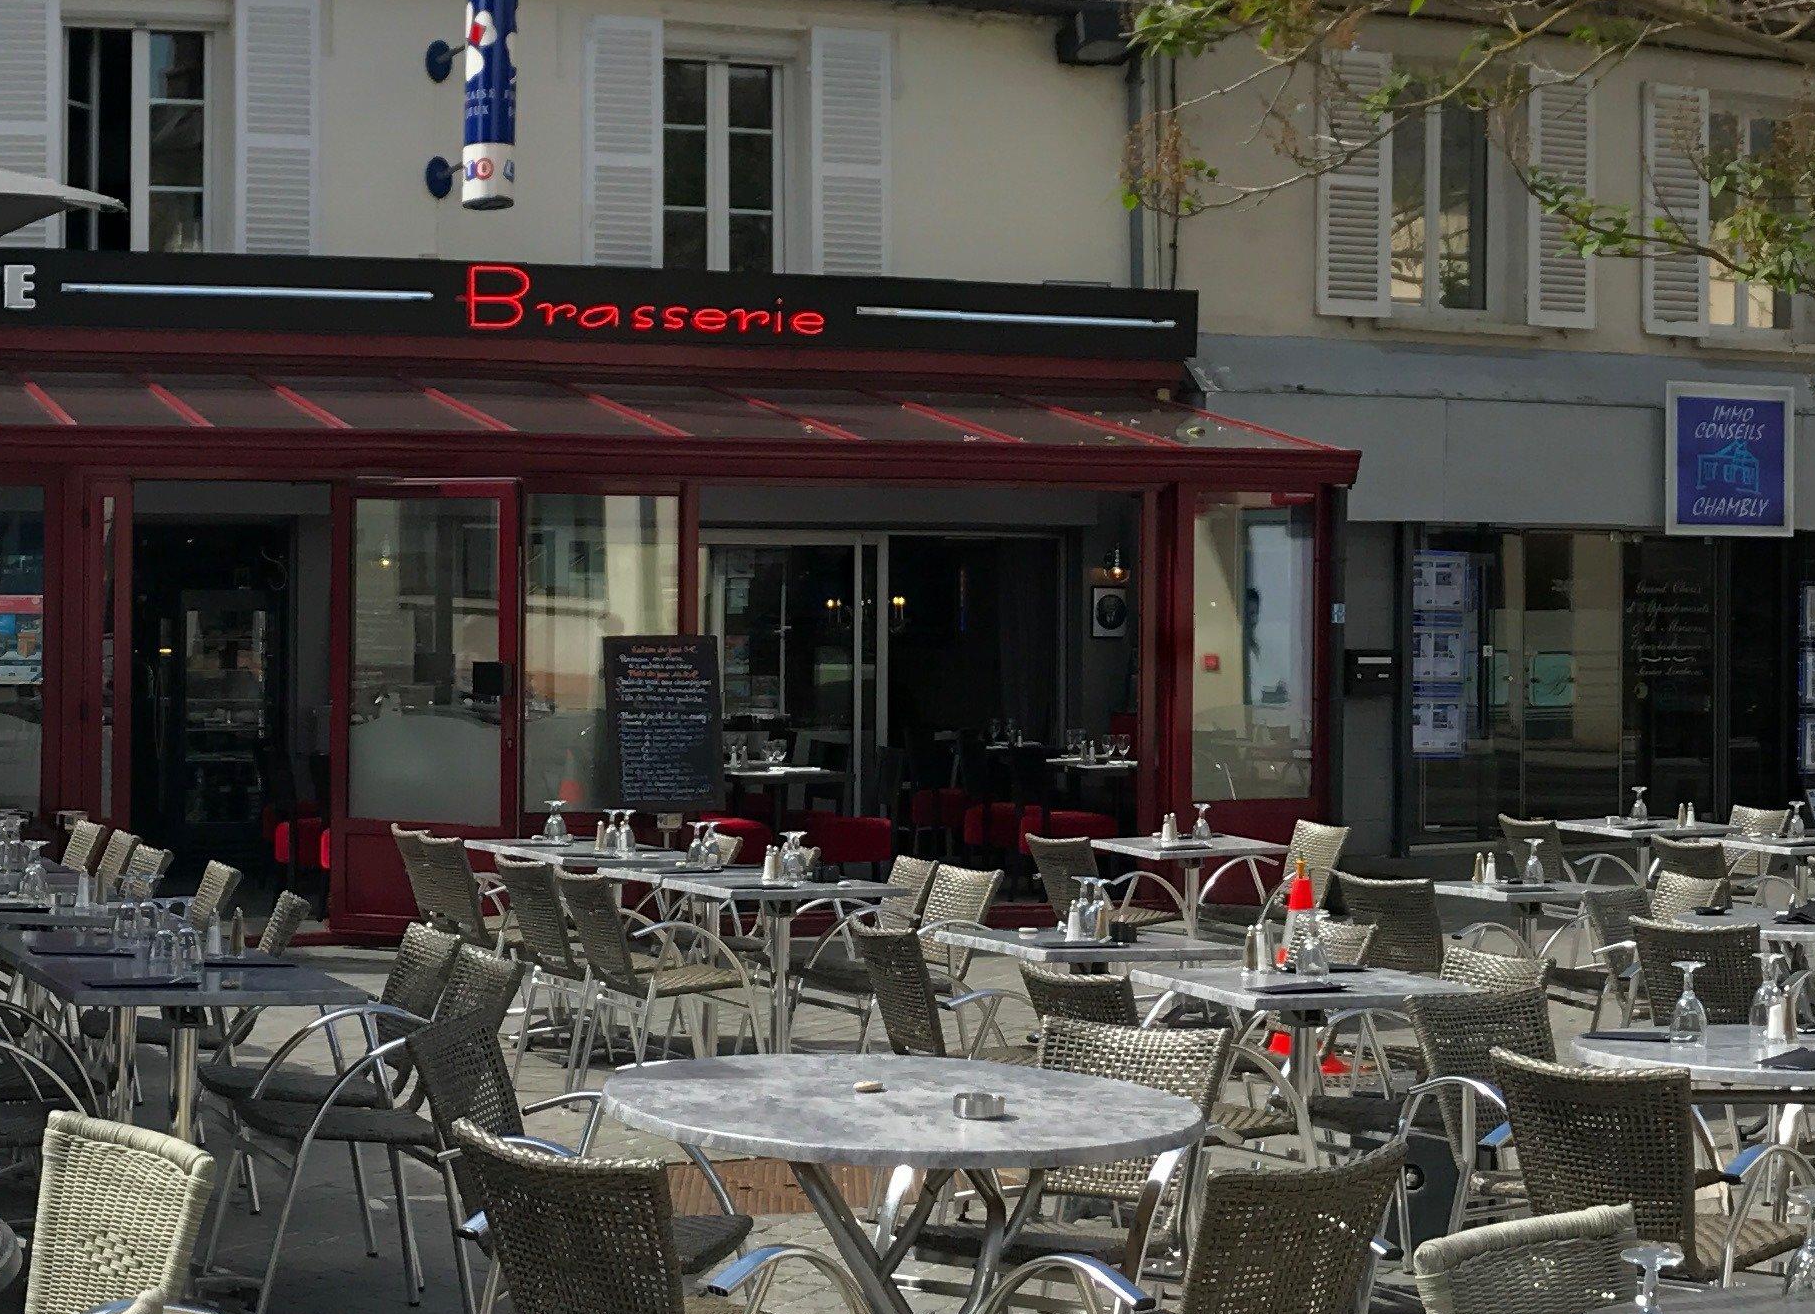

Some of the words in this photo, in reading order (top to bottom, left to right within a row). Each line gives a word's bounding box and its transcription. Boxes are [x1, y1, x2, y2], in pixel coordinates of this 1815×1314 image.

[467, 263, 825, 335] Brasserie
[1712, 405, 1754, 423] IMMO
[1694, 421, 1766, 441] CONSEILS
[1692, 496, 1770, 518] CHAMBLY
